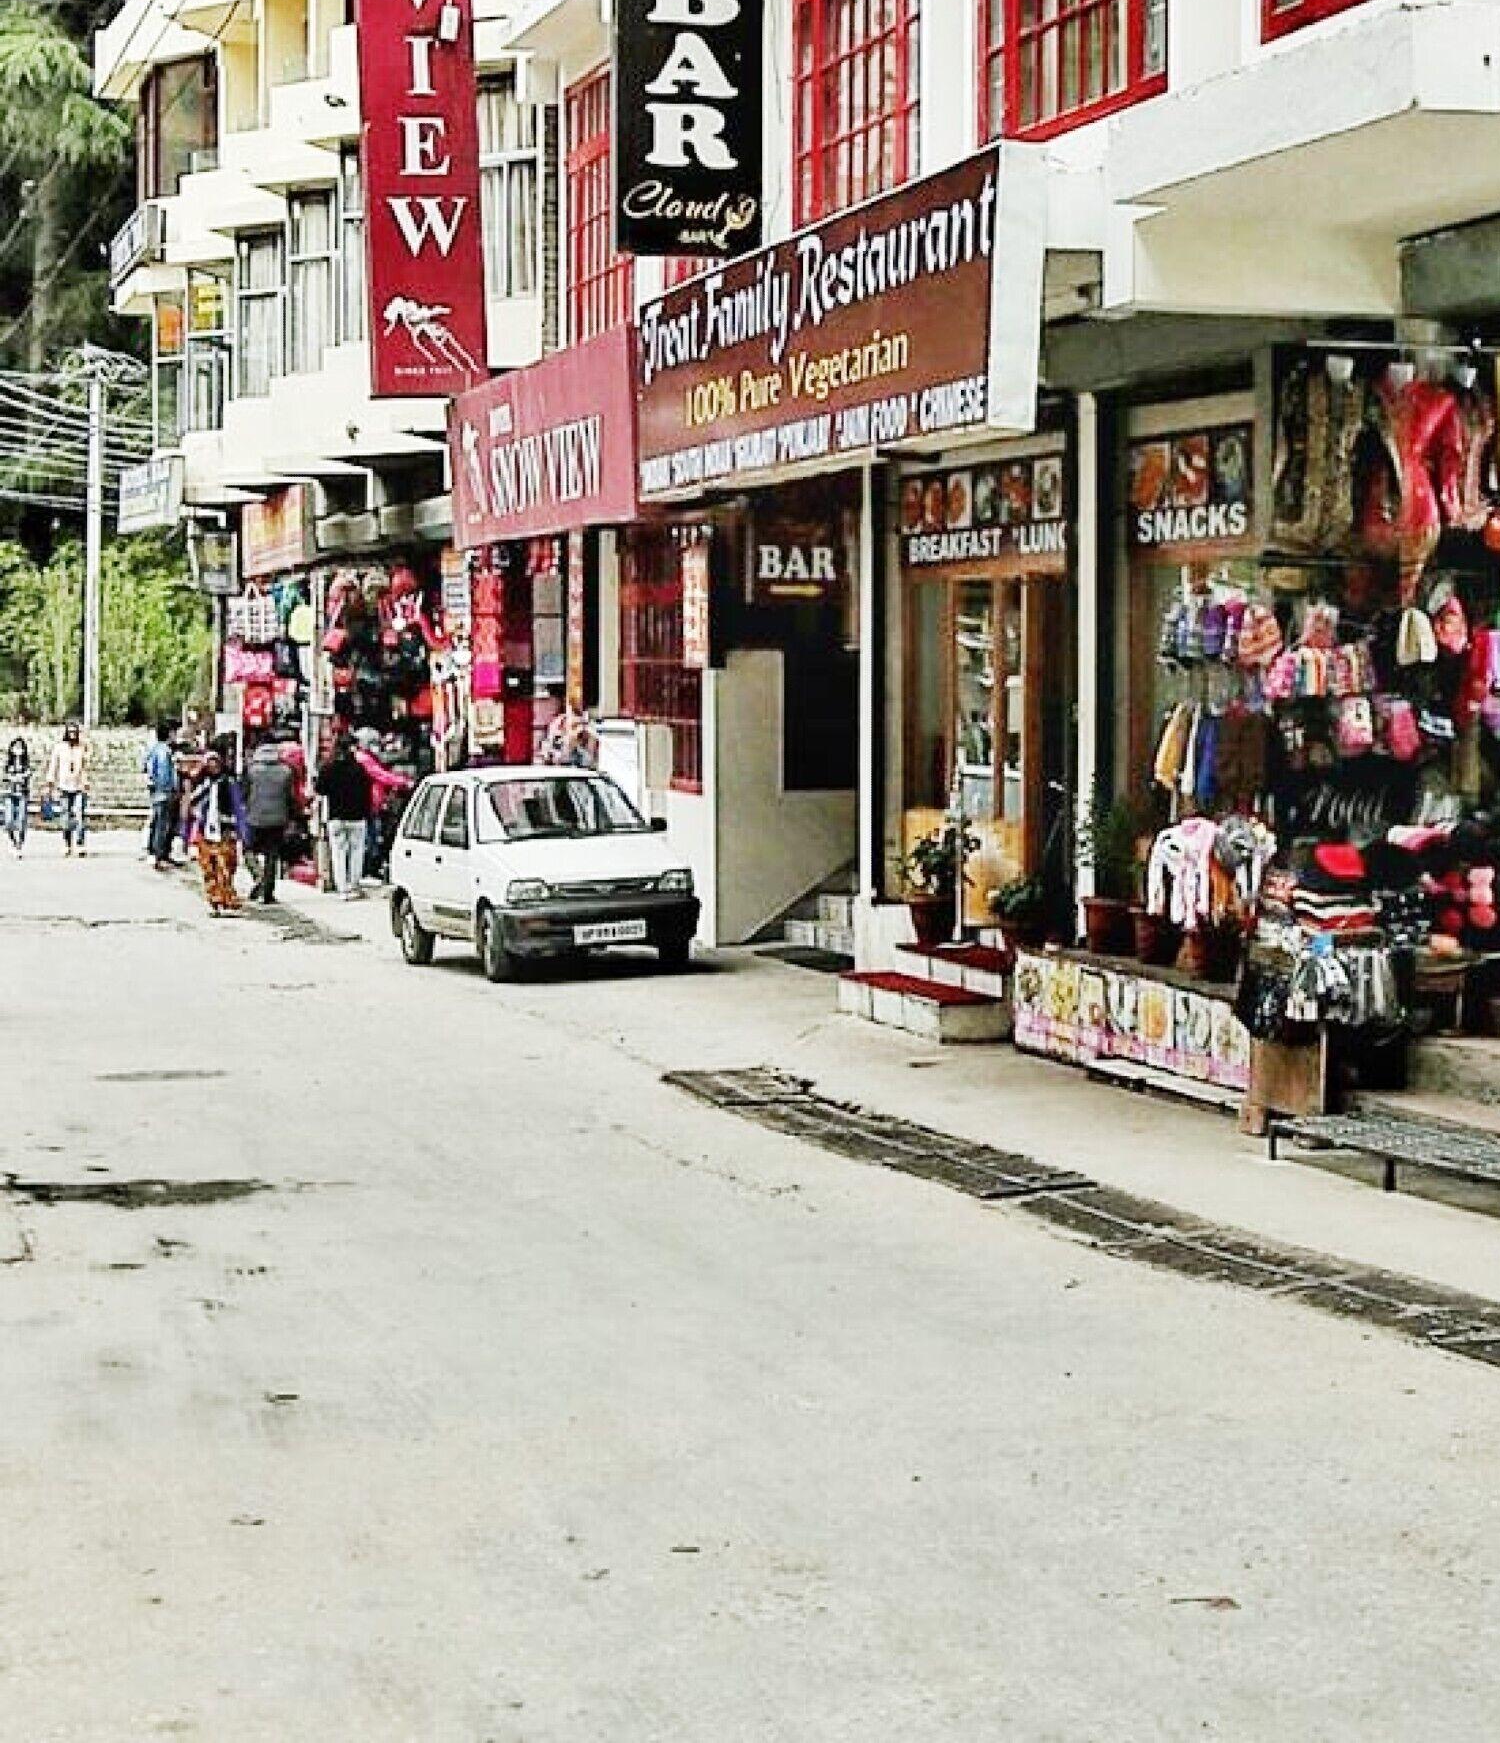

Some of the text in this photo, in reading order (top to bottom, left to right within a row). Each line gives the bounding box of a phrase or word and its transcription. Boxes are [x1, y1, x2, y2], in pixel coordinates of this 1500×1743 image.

[622, 179, 730, 223] Cloud
[700, 251, 791, 364] Family
[792, 171, 995, 331] Restaurant
[685, 329, 908, 428] 100% Pure Vegetarian
[491, 435, 544, 519] SNOW
[544, 414, 601, 506] VIEW
[908, 527, 1003, 564] BREAKFAST
[1136, 502, 1248, 546] SNACKS
[758, 544, 836, 581] BAR
